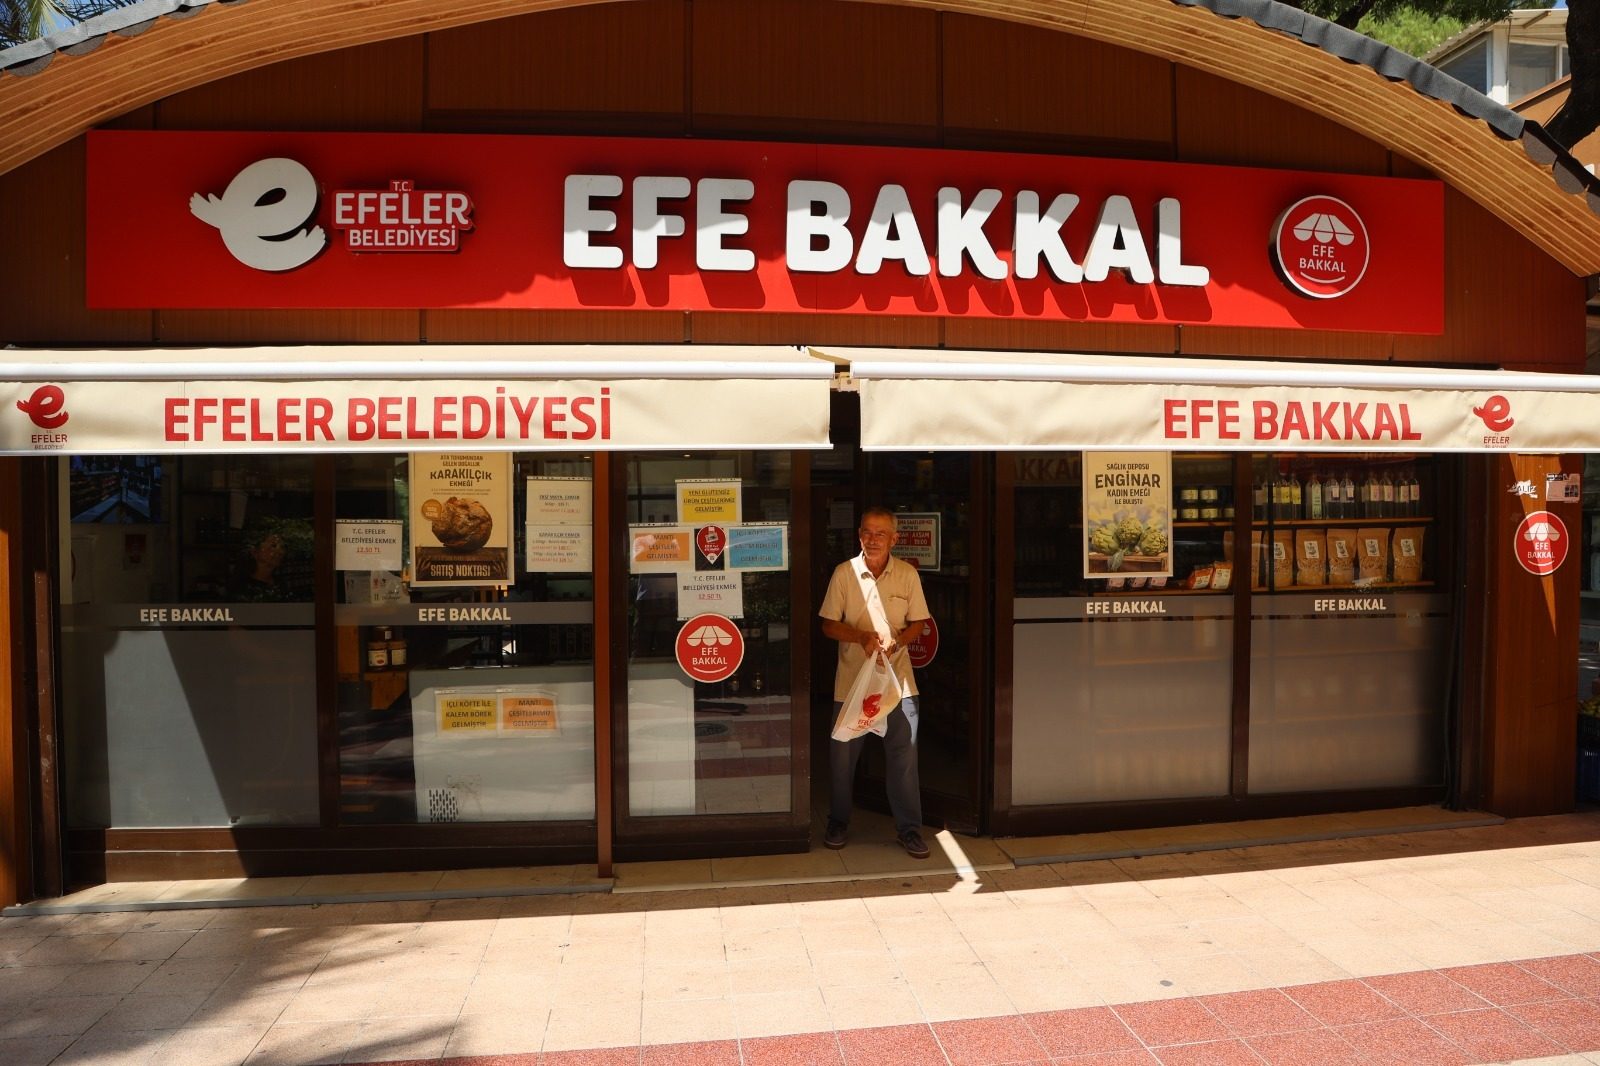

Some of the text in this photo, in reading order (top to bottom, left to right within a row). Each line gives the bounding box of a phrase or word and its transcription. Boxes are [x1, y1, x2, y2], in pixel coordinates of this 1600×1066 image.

[393, 182, 411, 192] T.C.
[336, 193, 468, 224] EFELER
[350, 225, 456, 246] BELEDİYESİ
[563, 174, 1210, 286] EFE BAKKAL
[1312, 245, 1334, 258] EFE
[1300, 258, 1346, 272] BAKKAL
[164, 386, 610, 442] EFELER BELEDİYESİ
[1164, 399, 1422, 440] EFE BAKKAL
[32, 434, 68, 443] EFELER
[1484, 436, 1510, 444] EFELER
[430, 468, 492, 482] KARAKILÇIK
[1095, 470, 1160, 488] ENGİNAR
[1130, 488, 1150, 496] EMEĞİ
[430, 564, 490, 578] SATIŞ NOKTASI
[1086, 601, 1166, 614] EFE BAKKAL
[1314, 599, 1386, 610] EFE BAKKAL
[140, 608, 234, 622] EFE BAKKAL
[418, 608, 511, 621] EFE BAKKAL
[702, 647, 718, 656] EFE
[692, 657, 728, 665] BAKKAL
